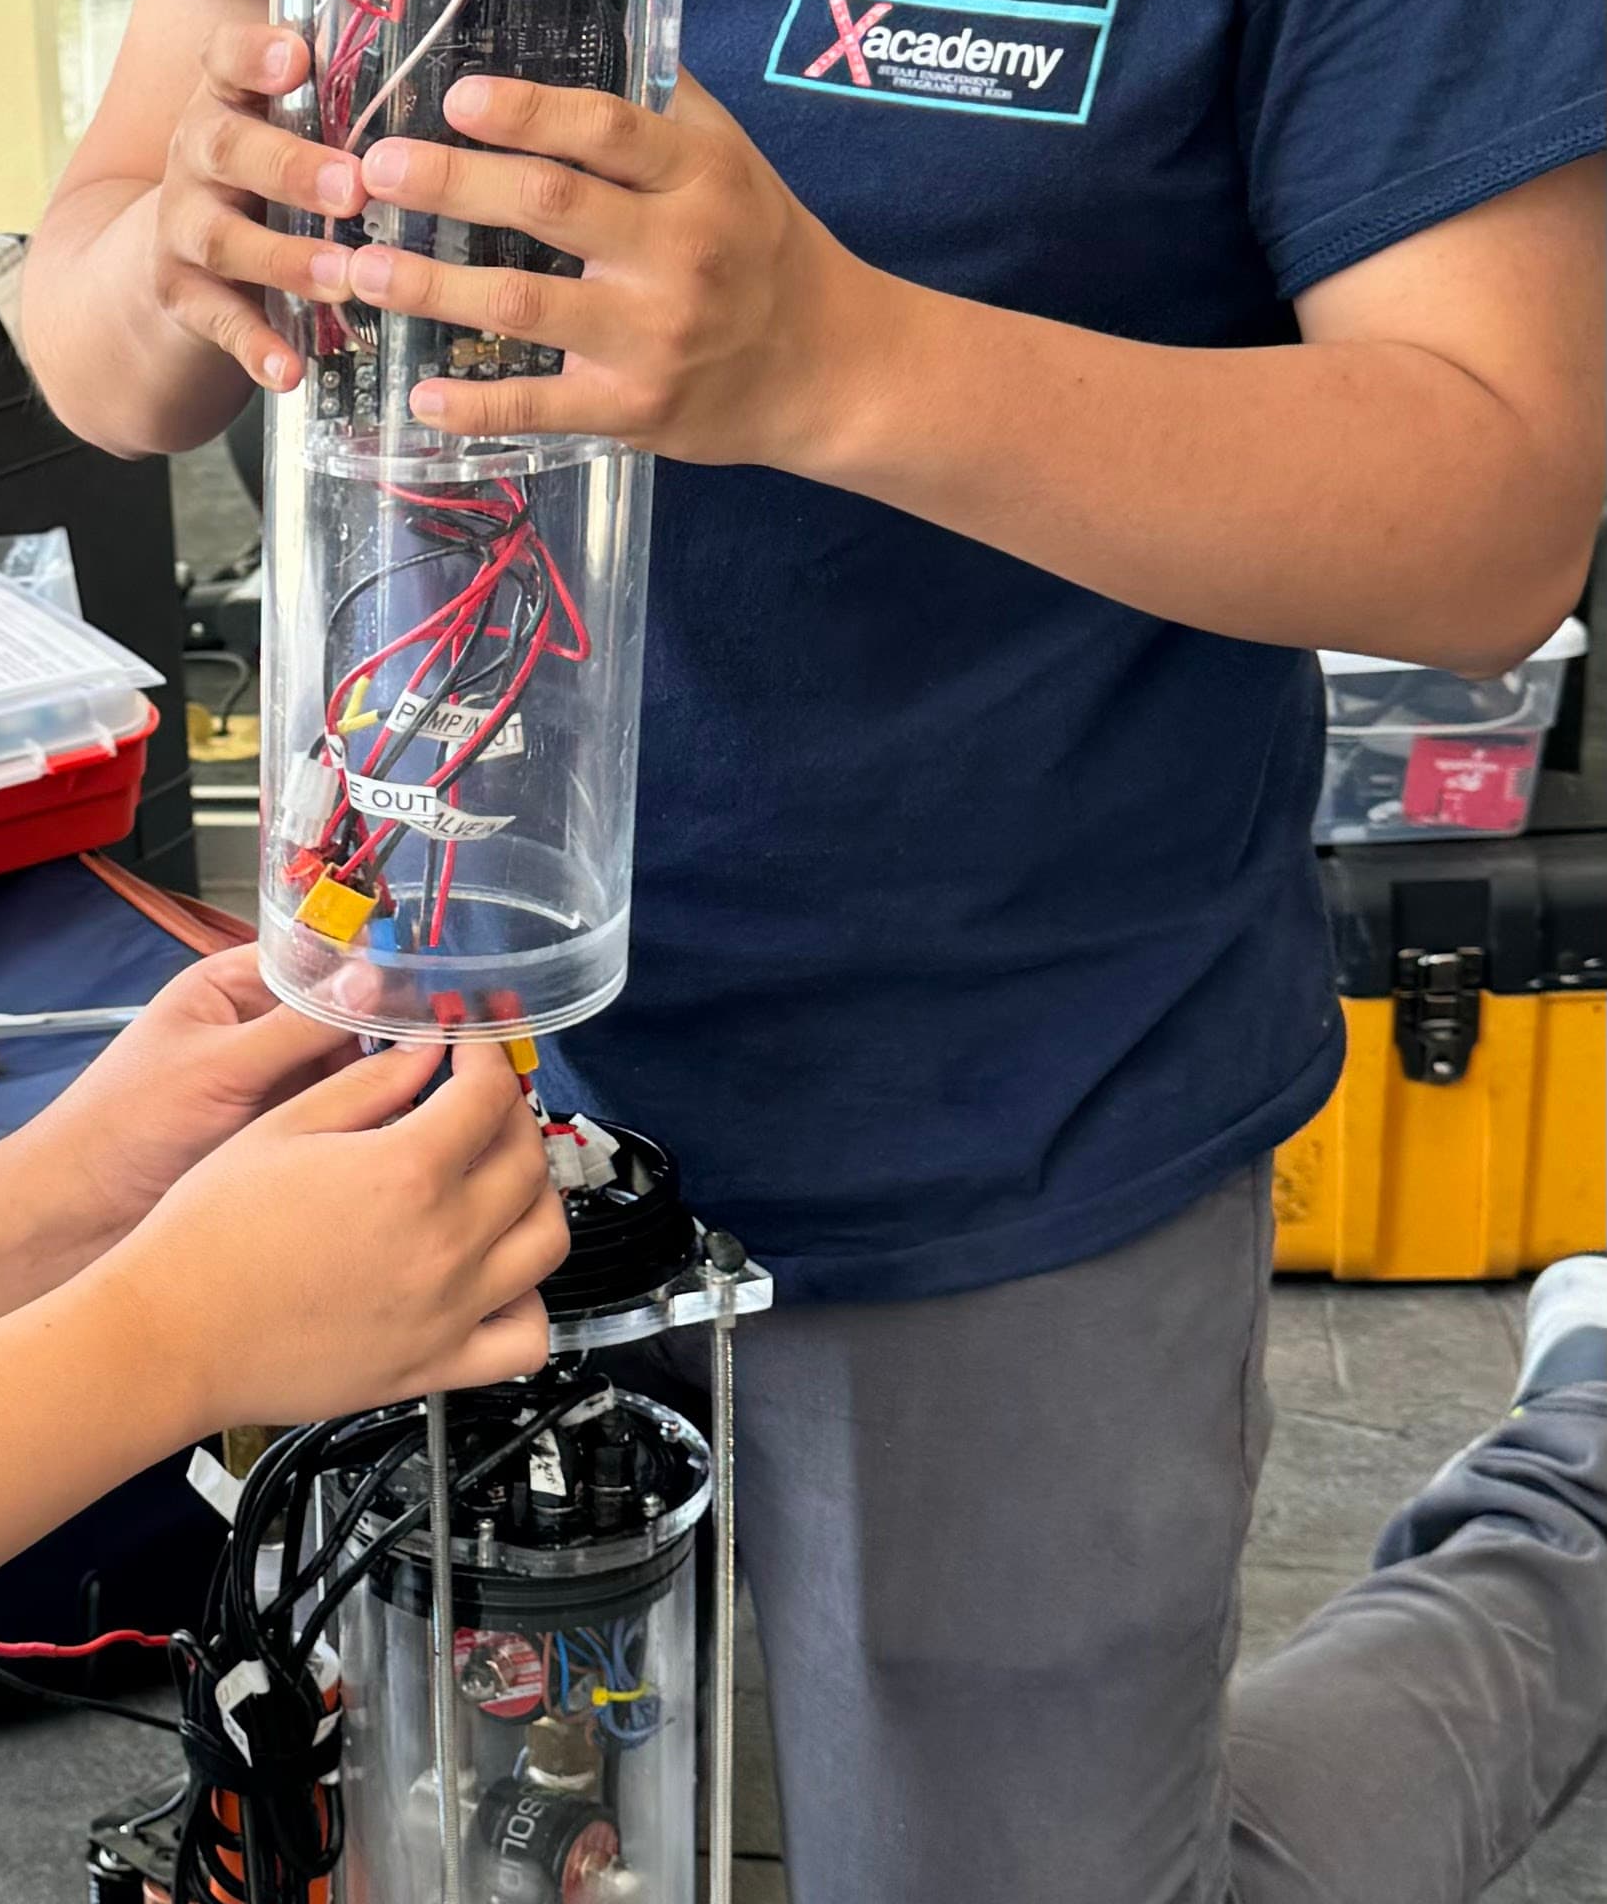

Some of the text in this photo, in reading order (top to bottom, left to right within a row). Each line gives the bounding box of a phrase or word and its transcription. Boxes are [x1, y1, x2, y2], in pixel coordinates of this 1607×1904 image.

[395, 701, 462, 733] PMP
[371, 788, 437, 814] OUT
[431, 812, 482, 836] ALVE
[498, 1796, 545, 1894] SOLID
